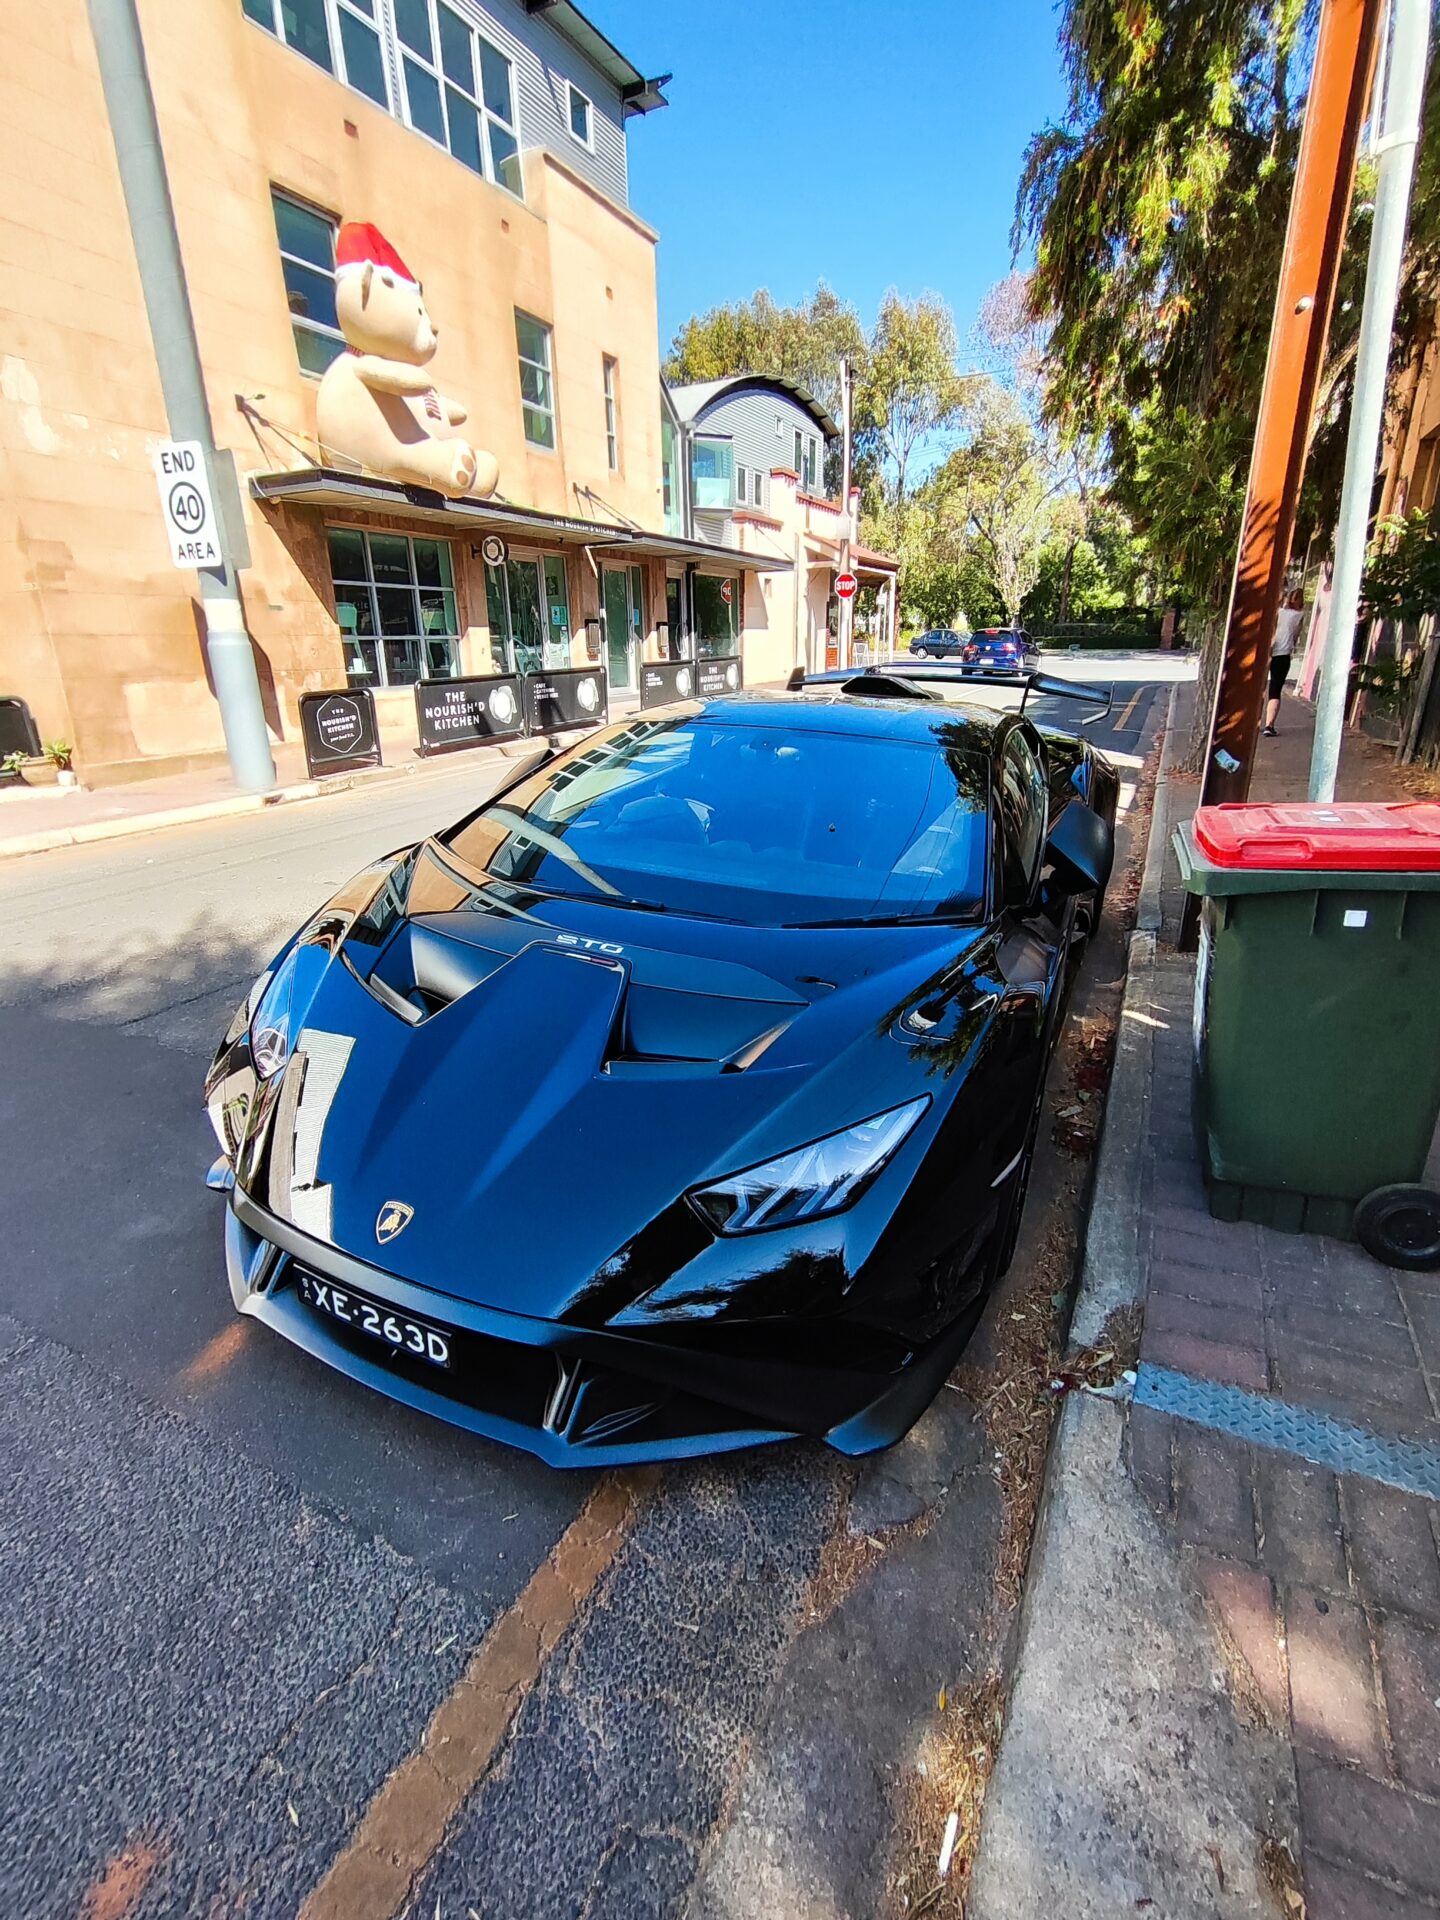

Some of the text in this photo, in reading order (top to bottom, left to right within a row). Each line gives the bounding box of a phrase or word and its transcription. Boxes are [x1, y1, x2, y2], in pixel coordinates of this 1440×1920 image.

[161, 450, 195, 474] END
[175, 494, 200, 521] 40
[178, 542, 216, 561] AREA
[836, 580, 855, 591] STOP
[445, 691, 466, 703] THE
[425, 701, 485, 719] NOURISH'D
[321, 714, 357, 727] NOURISH'D
[327, 723, 354, 734] KITCHEN
[434, 714, 480, 731] KITCHEN
[556, 934, 624, 954] STO
